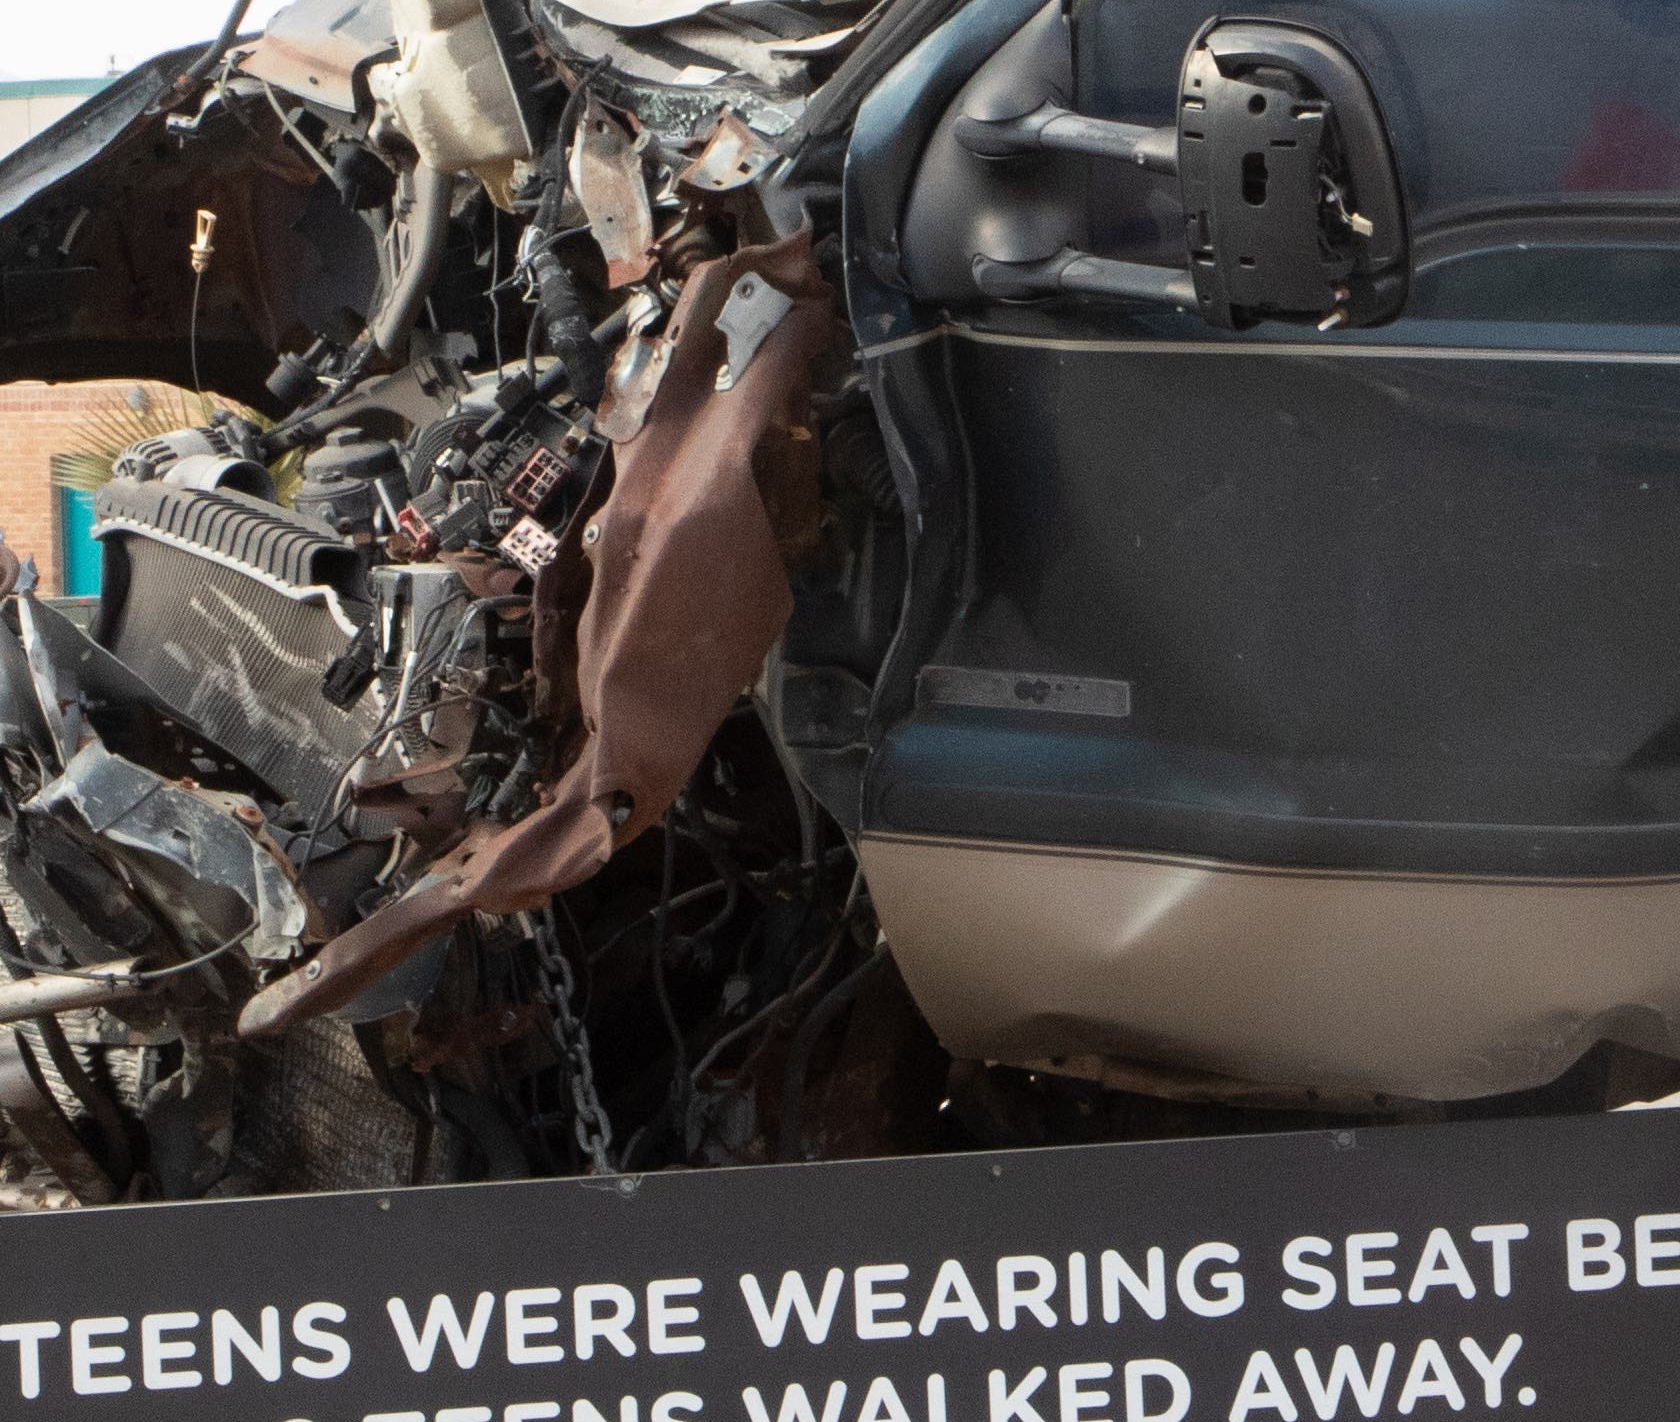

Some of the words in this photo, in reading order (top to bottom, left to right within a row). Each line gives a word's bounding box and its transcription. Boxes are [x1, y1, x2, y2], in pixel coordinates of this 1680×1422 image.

[387, 1278, 705, 1372] WERE
[740, 1242, 1244, 1347] WEARING
[1282, 1224, 1528, 1310] SEAT
